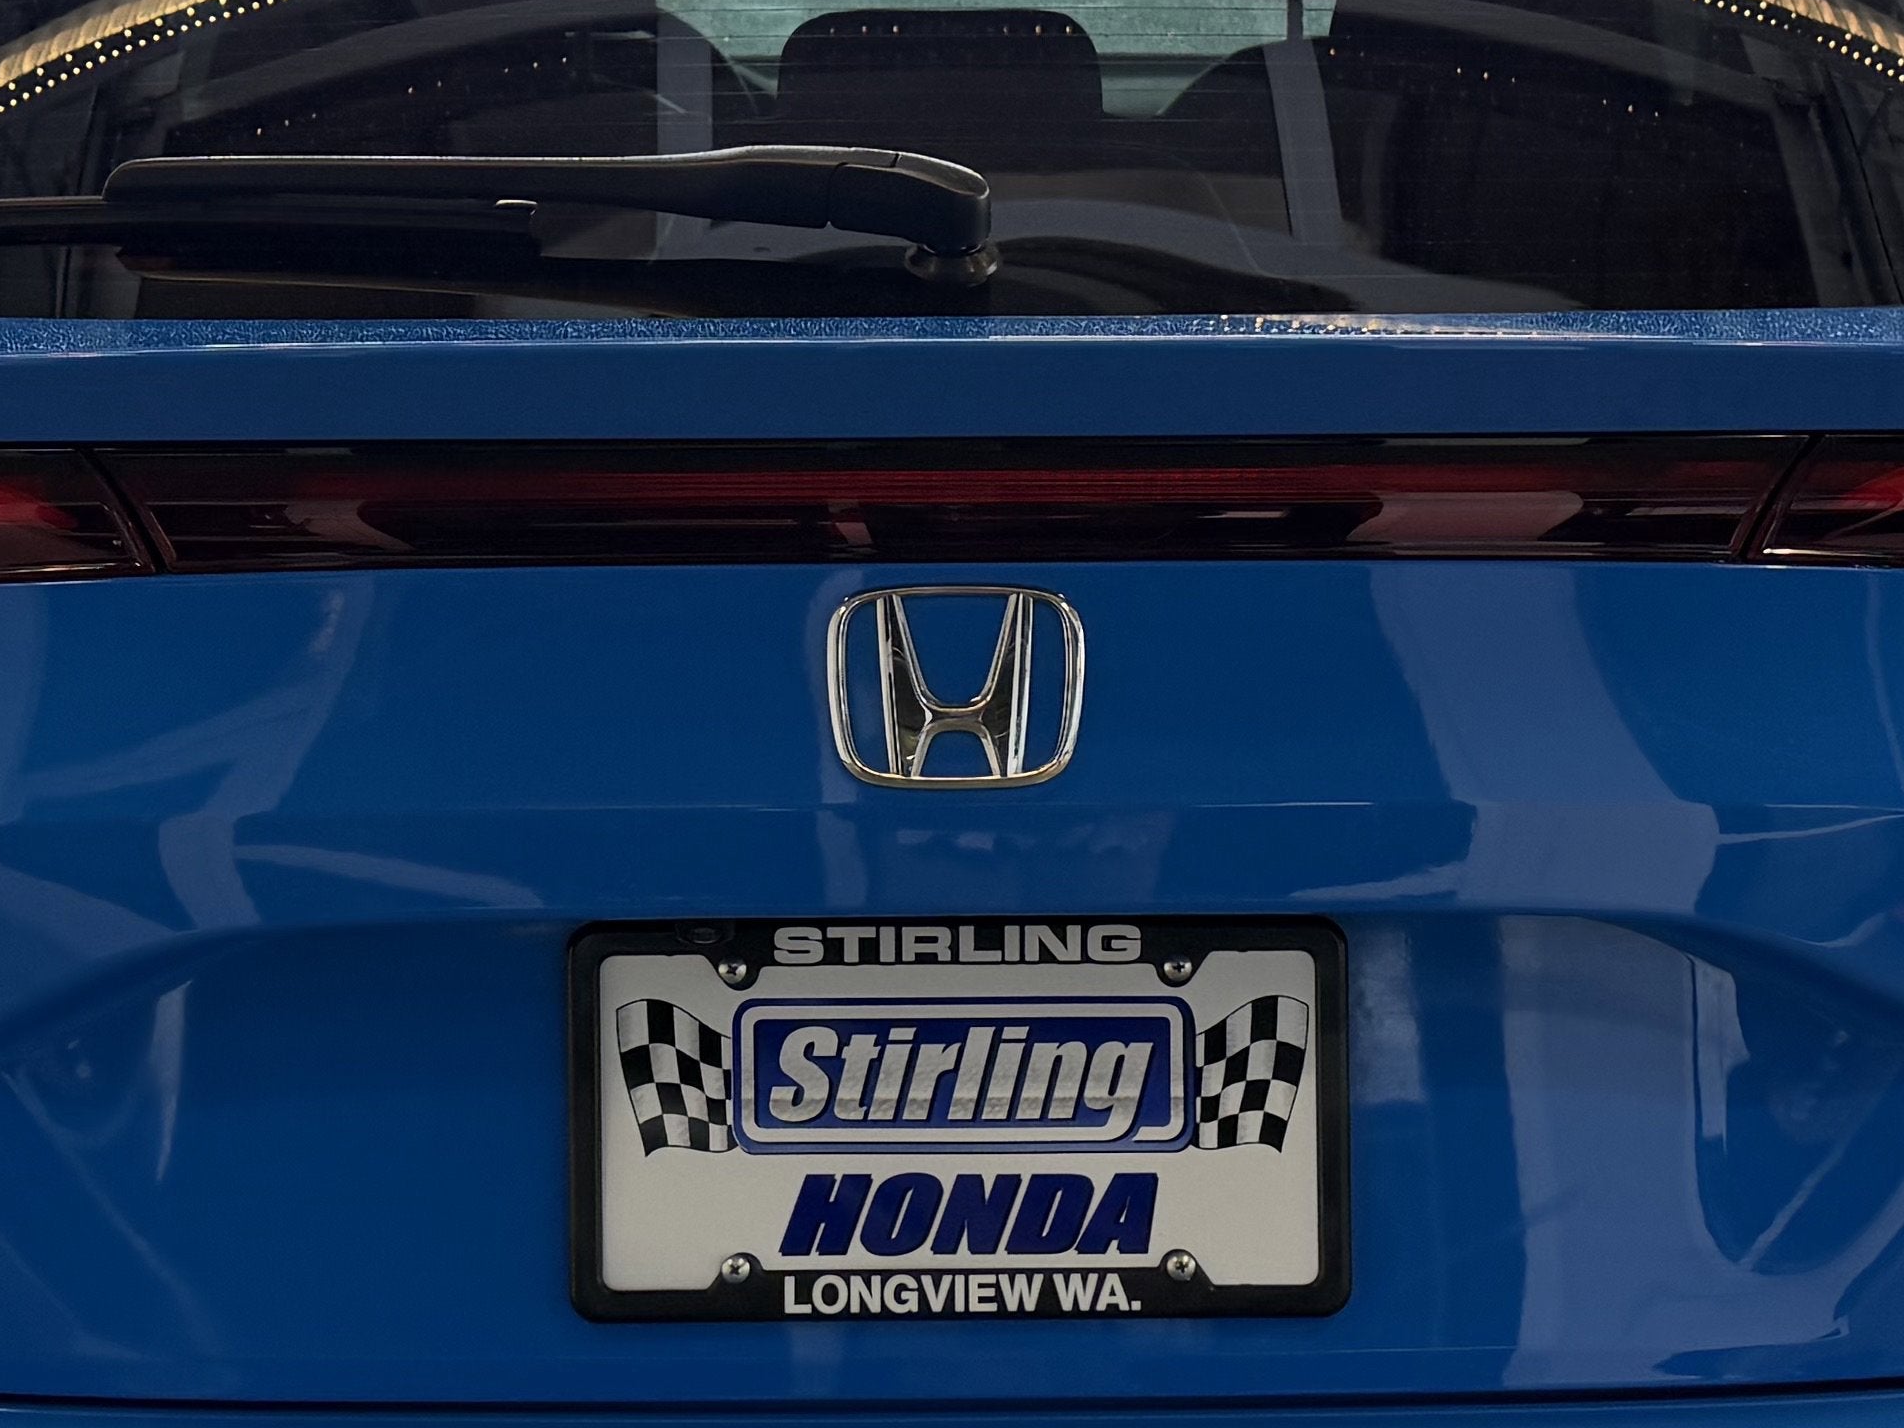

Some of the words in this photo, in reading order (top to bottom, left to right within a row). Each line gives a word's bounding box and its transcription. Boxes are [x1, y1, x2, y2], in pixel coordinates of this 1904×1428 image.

[773, 924, 1142, 964] STIRLING
[769, 1025, 1154, 1143] Stirling
[778, 1171, 1160, 1258] HONDA
[783, 1273, 1044, 1315] LONGVIEW
[1052, 1272, 1142, 1312] WA.
